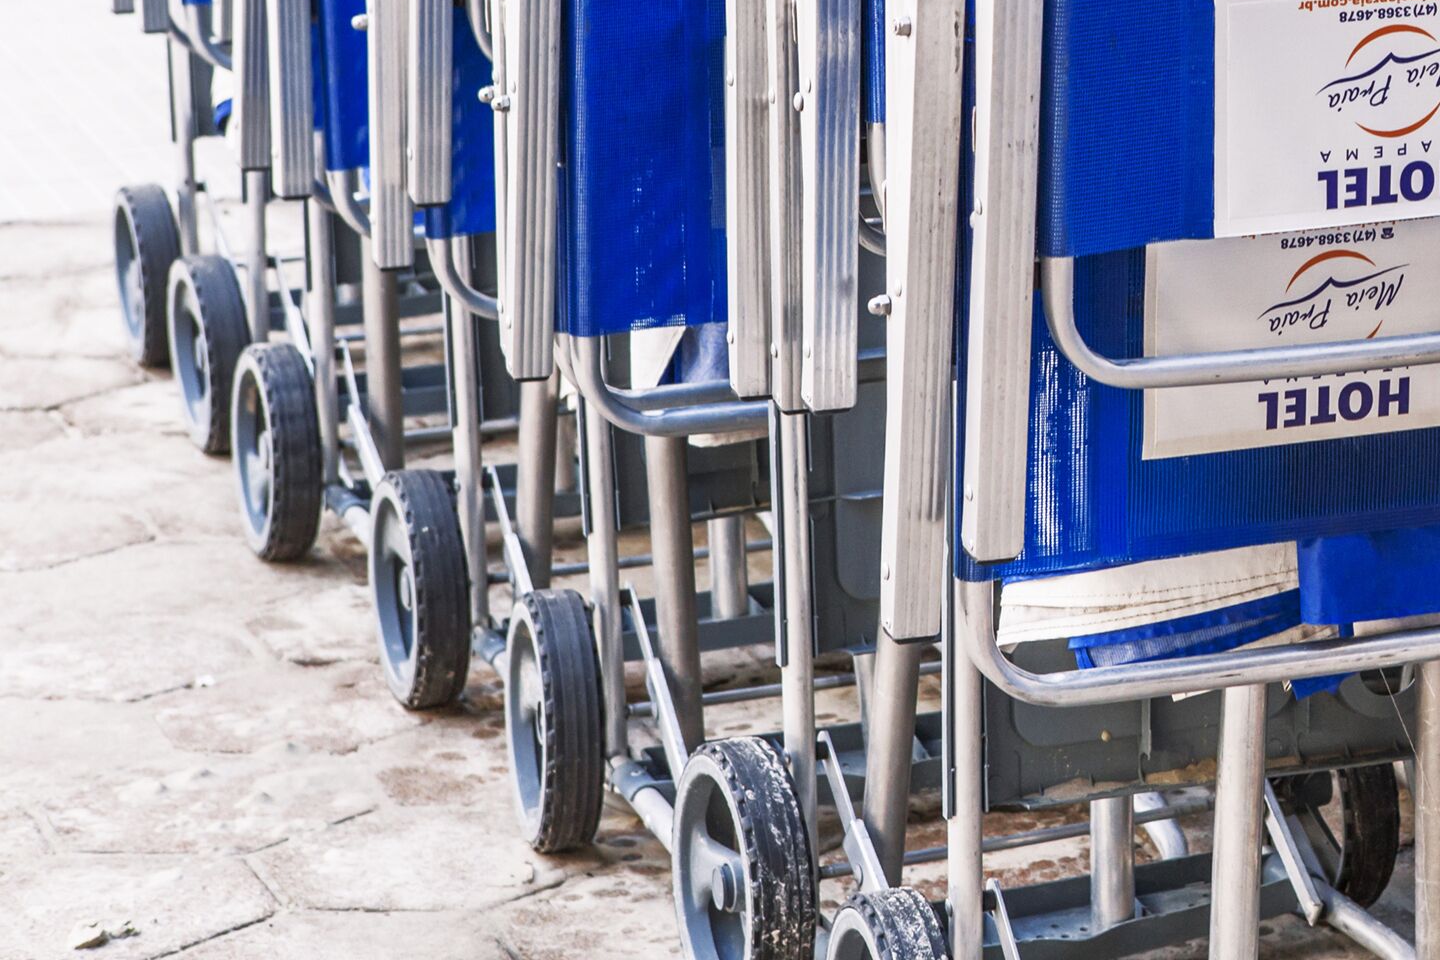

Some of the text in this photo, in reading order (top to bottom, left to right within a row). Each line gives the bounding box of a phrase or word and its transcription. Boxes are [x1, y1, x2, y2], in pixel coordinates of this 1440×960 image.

[1327, 74, 1392, 112] Praia
[1269, 273, 1404, 336] Meia Praia
[1258, 376, 1411, 431] HOTEL
